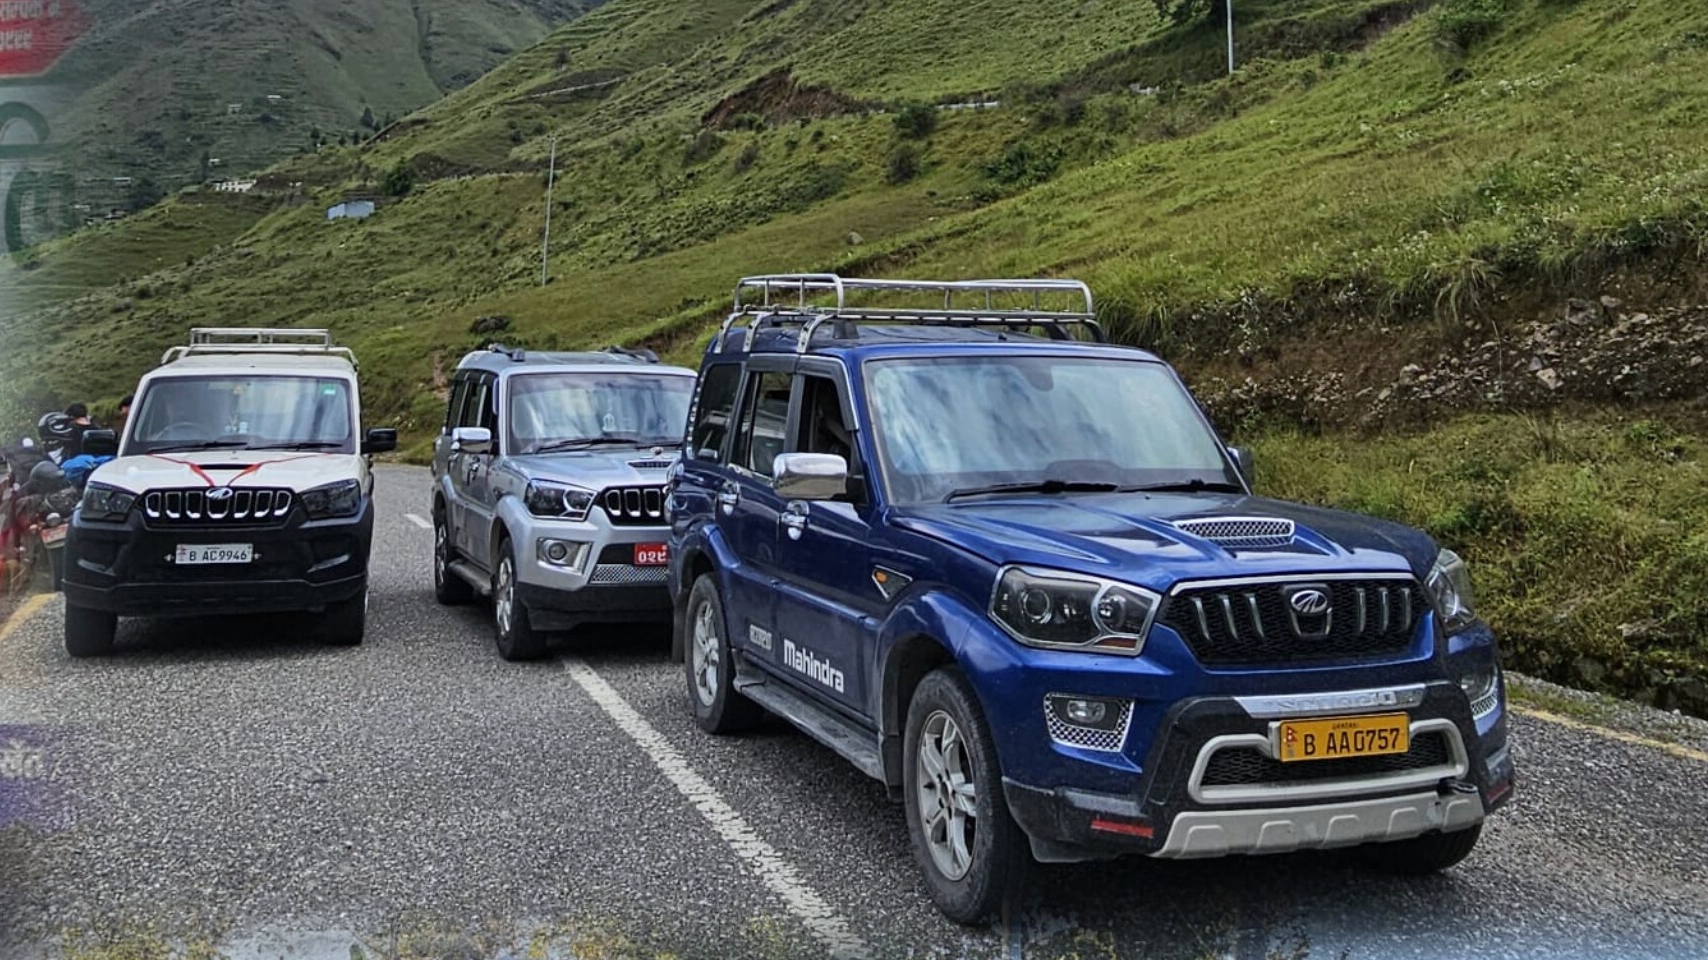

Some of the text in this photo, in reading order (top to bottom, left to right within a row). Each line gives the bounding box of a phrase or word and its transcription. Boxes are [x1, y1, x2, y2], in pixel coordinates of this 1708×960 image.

[189, 550, 197, 561] B
[784, 638, 844, 693] Mahindra
[1304, 727, 1400, 755] B AA0757
